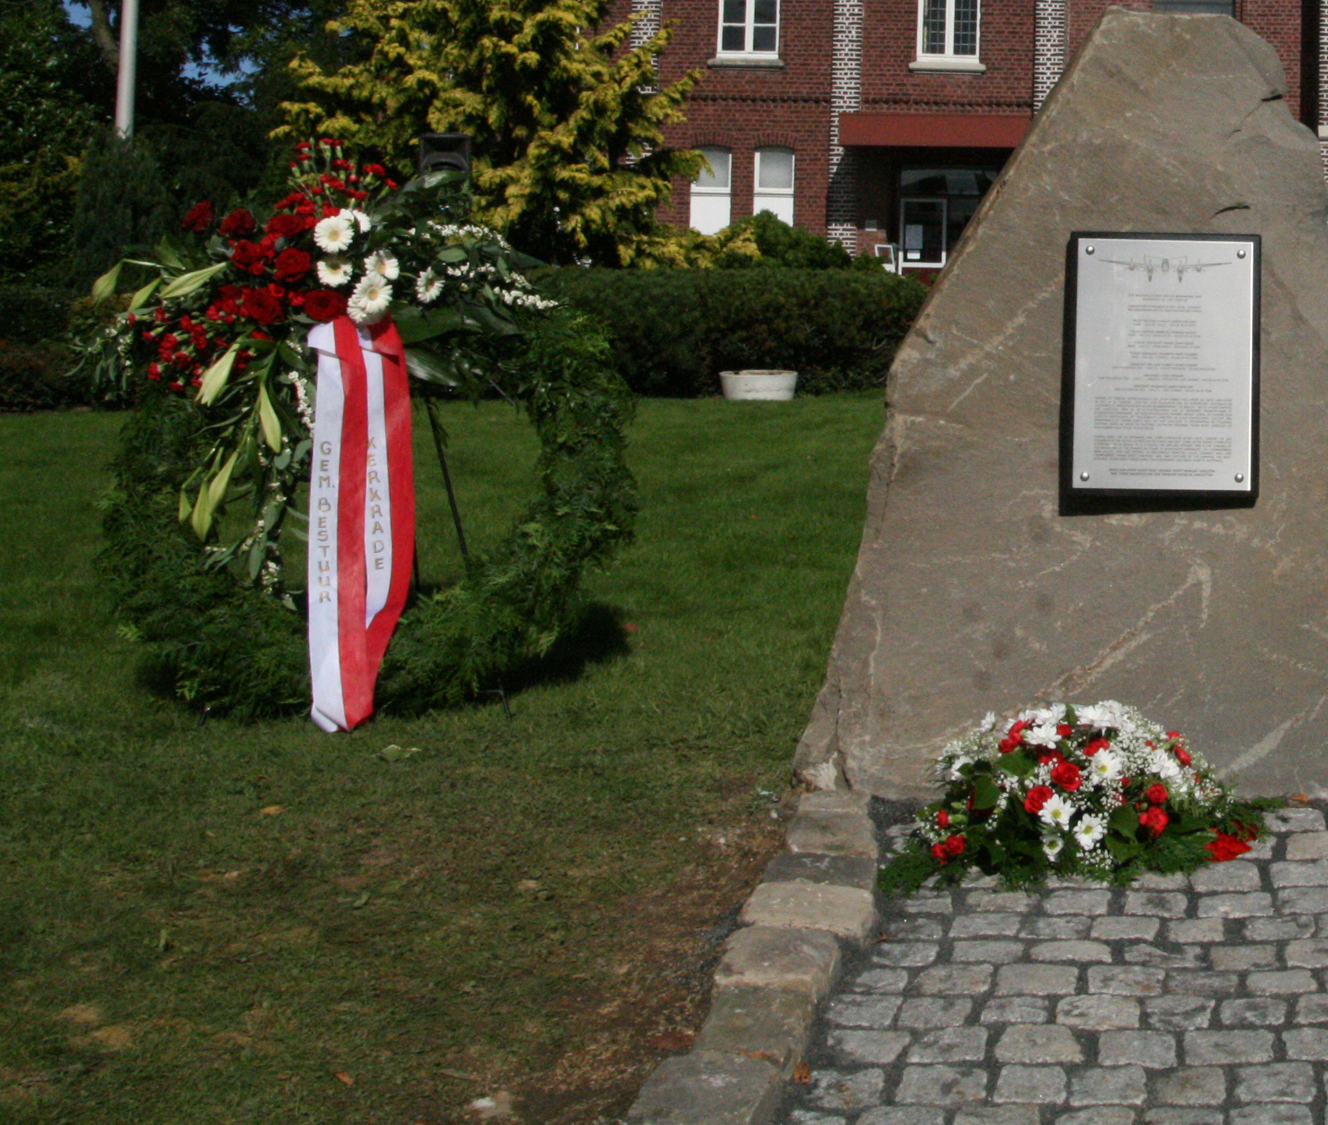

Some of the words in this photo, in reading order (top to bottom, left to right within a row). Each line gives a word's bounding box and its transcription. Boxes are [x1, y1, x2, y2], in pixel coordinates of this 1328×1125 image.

[318, 440, 336, 489] GEM.
[367, 436, 386, 572] KERKRADE
[317, 496, 332, 605] BESTUUR
